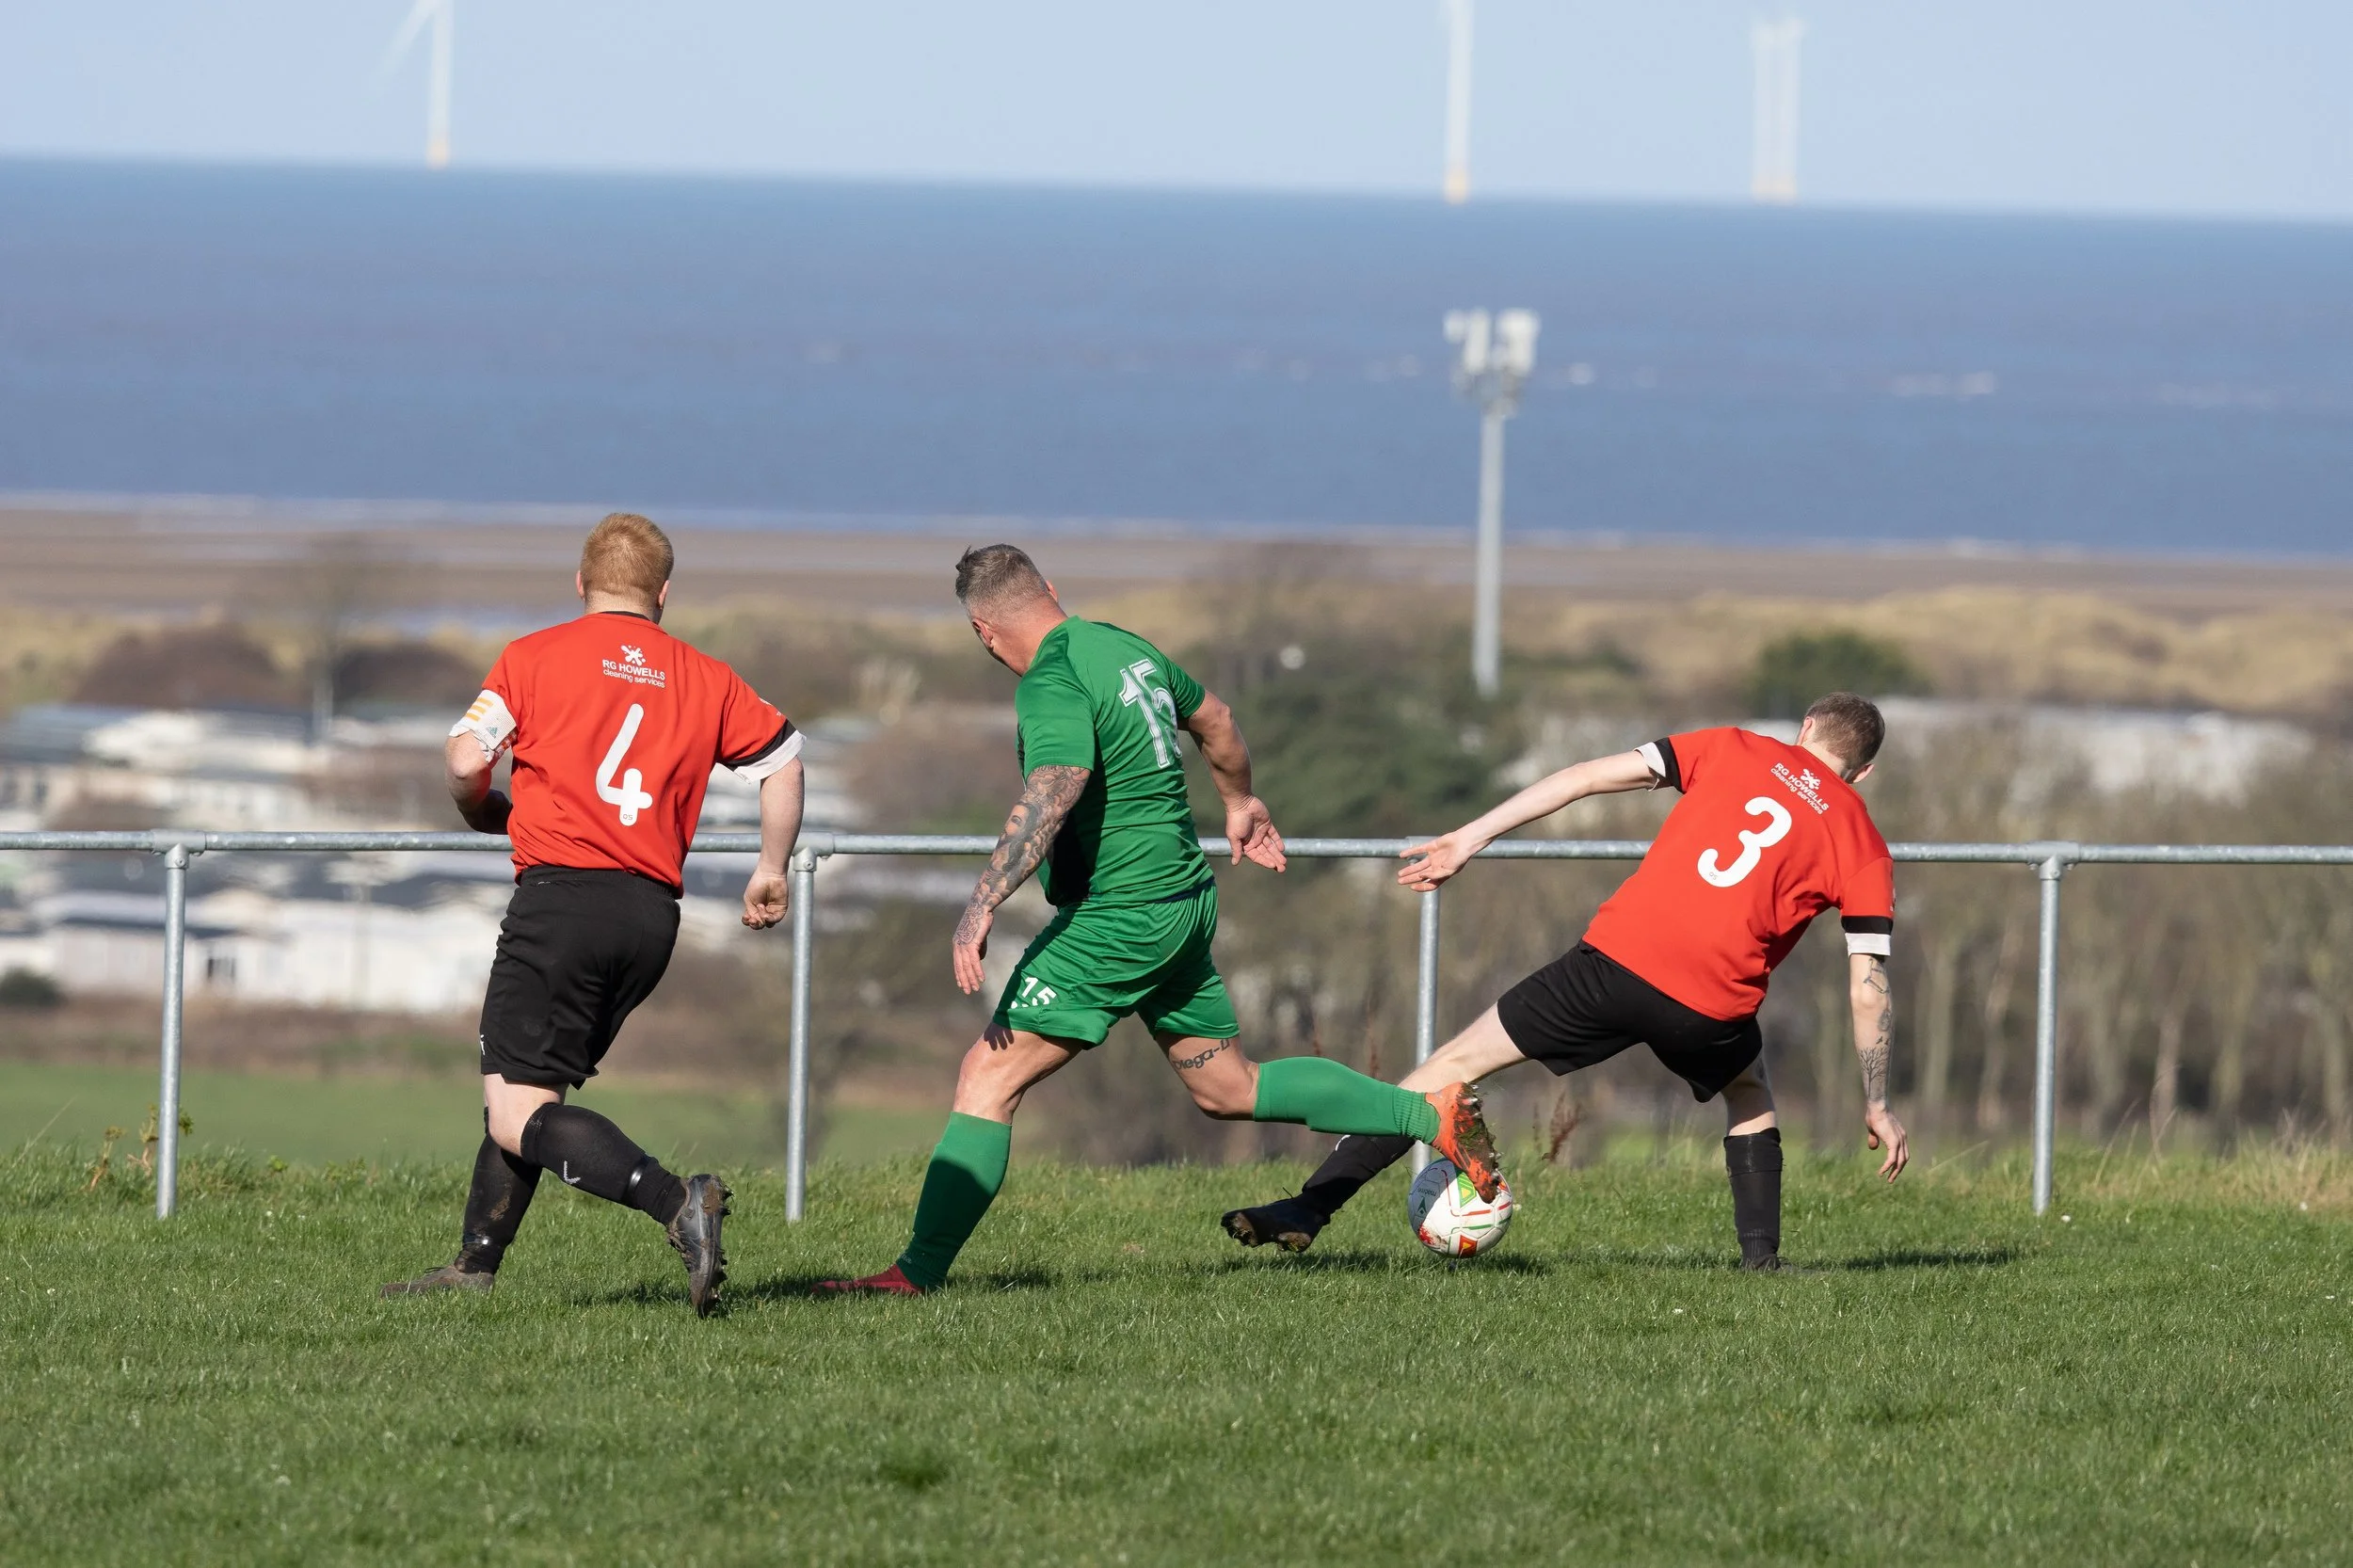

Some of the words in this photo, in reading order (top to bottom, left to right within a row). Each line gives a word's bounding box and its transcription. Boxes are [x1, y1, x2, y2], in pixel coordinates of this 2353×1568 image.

[602, 659, 616, 670] RG
[618, 663, 665, 680] HOWELLS
[602, 669, 633, 683] cleaning
[634, 677, 665, 688] services
[1119, 659, 1182, 769] 15
[596, 703, 652, 826] 4
[1774, 762, 1790, 776] RG
[1787, 775, 1829, 810] HOWELLS
[1770, 768, 1798, 792] cleaning
[1797, 791, 1823, 814] services
[1697, 796, 1792, 888] 3
[1021, 976, 1057, 1006] 15
